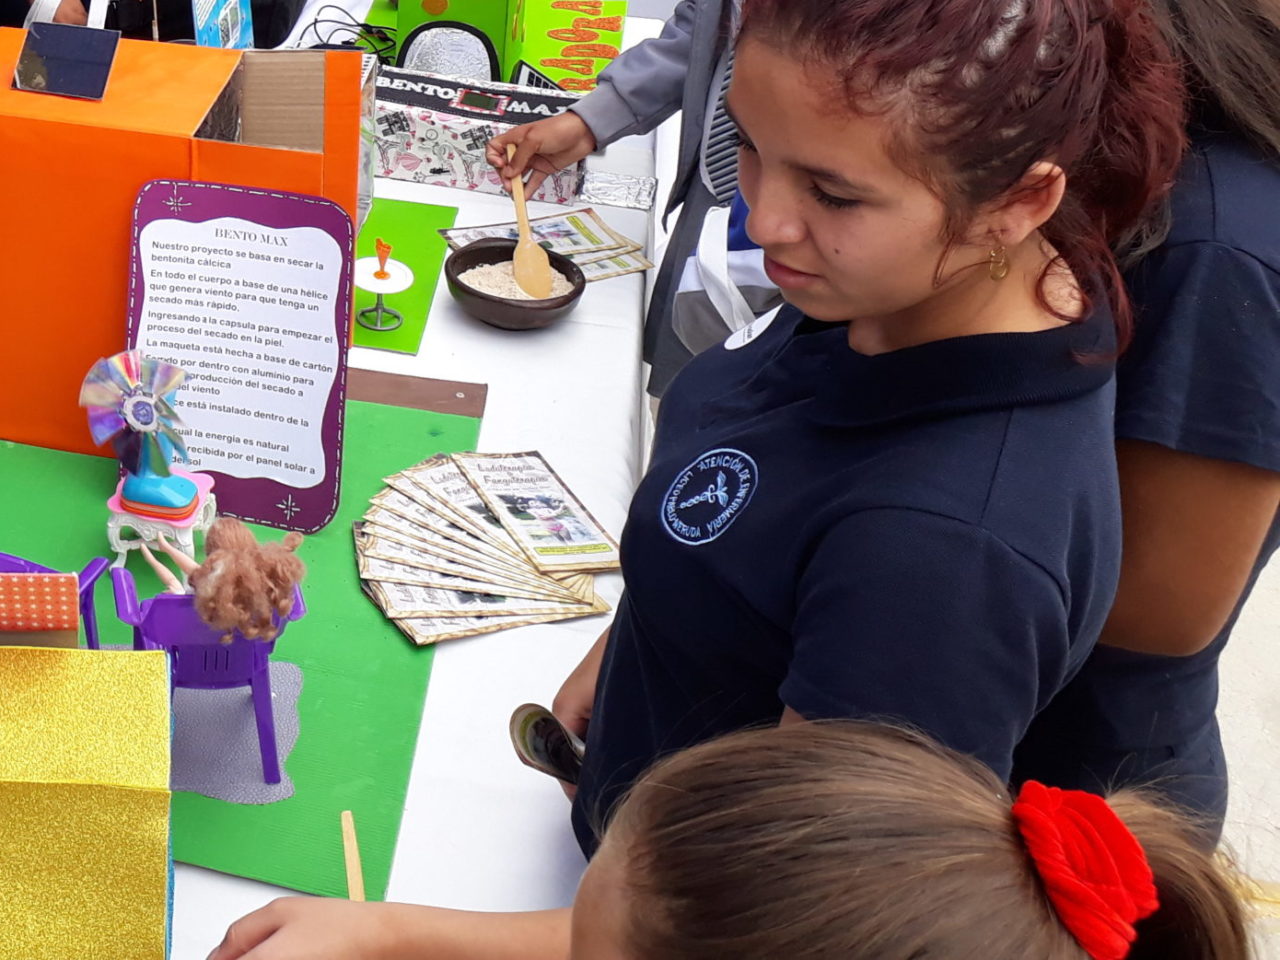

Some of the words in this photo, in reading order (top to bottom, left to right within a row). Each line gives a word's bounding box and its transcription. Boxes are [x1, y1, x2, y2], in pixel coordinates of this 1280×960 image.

[376, 76, 454, 100] BENTO
[215, 228, 257, 242] BENTO
[260, 234, 288, 247] MAX
[151, 253, 195, 265] bentonita
[152, 241, 189, 252] Nuestro
[191, 246, 234, 256] proyecto
[249, 251, 271, 262] basa
[287, 258, 314, 268] secar
[315, 262, 324, 270] la
[150, 269, 162, 277] En
[165, 271, 186, 280] todo
[198, 275, 232, 285] cuerpo
[242, 279, 265, 290] base
[267, 283, 279, 292] de
[281, 287, 298, 295] una
[300, 288, 328, 301] hélice
[149, 296, 183, 305] secado
[206, 301, 240, 312] rápido.
[169, 285, 202, 294] genera
[205, 288, 233, 298] viento
[235, 293, 257, 301] para
[259, 296, 277, 304] que
[279, 298, 305, 310] tenga
[147, 324, 186, 334] proceso
[187, 327, 202, 335] del
[204, 330, 238, 340] secado
[254, 335, 263, 344] la
[265, 339, 284, 347] piel.
[148, 310, 201, 323] Ingresando
[209, 316, 217, 324] la
[258, 325, 280, 334] para
[282, 329, 322, 341] empezar
[324, 336, 333, 344] el
